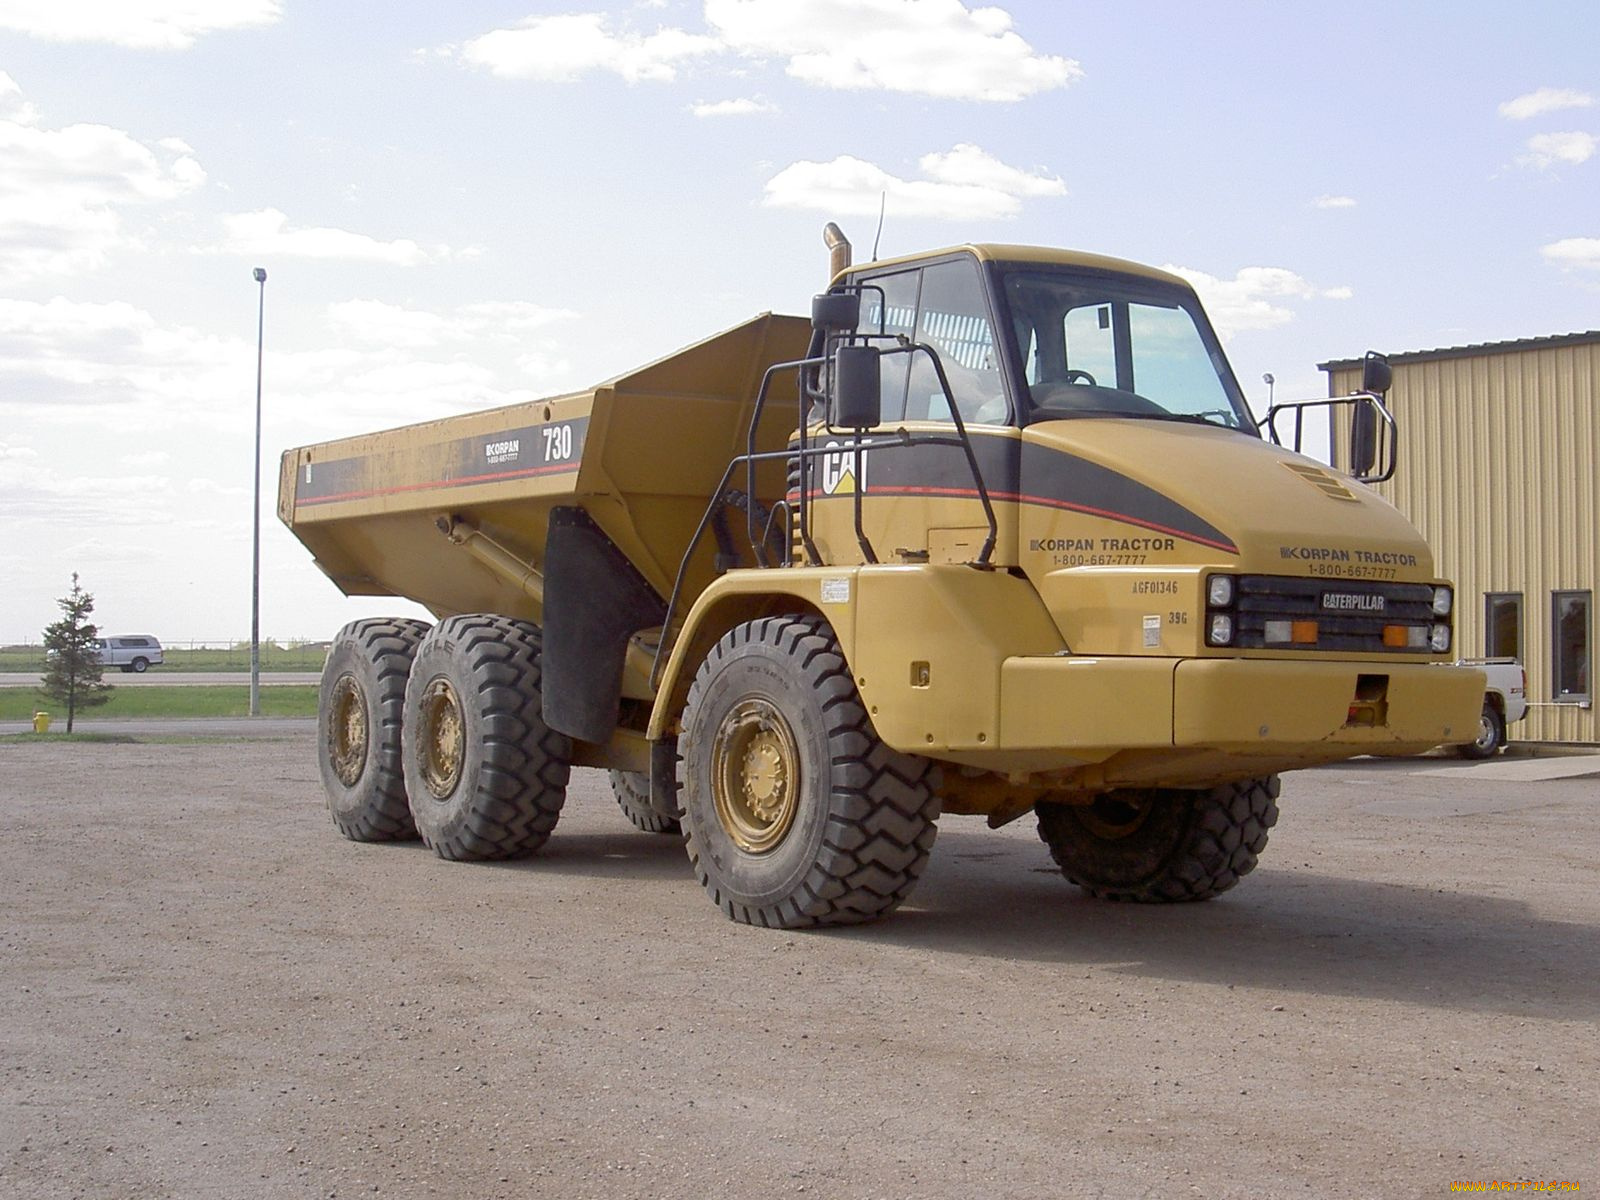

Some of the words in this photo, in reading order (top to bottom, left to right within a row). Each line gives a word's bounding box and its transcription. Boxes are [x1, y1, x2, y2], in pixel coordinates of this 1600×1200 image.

[486, 440, 519, 456] KORPAN
[543, 425, 572, 462] 730
[823, 439, 872, 495] CAT
[1030, 538, 1094, 551] KORPAN
[1101, 538, 1175, 551] TRACTOR
[1053, 554, 1147, 565] 1-800-667-7777
[1280, 547, 1350, 561] KORPAN
[1354, 551, 1417, 567] TRACTOR
[1308, 564, 1396, 579] 1-800-667-7777
[1323, 593, 1385, 610] CATERPILLAR
